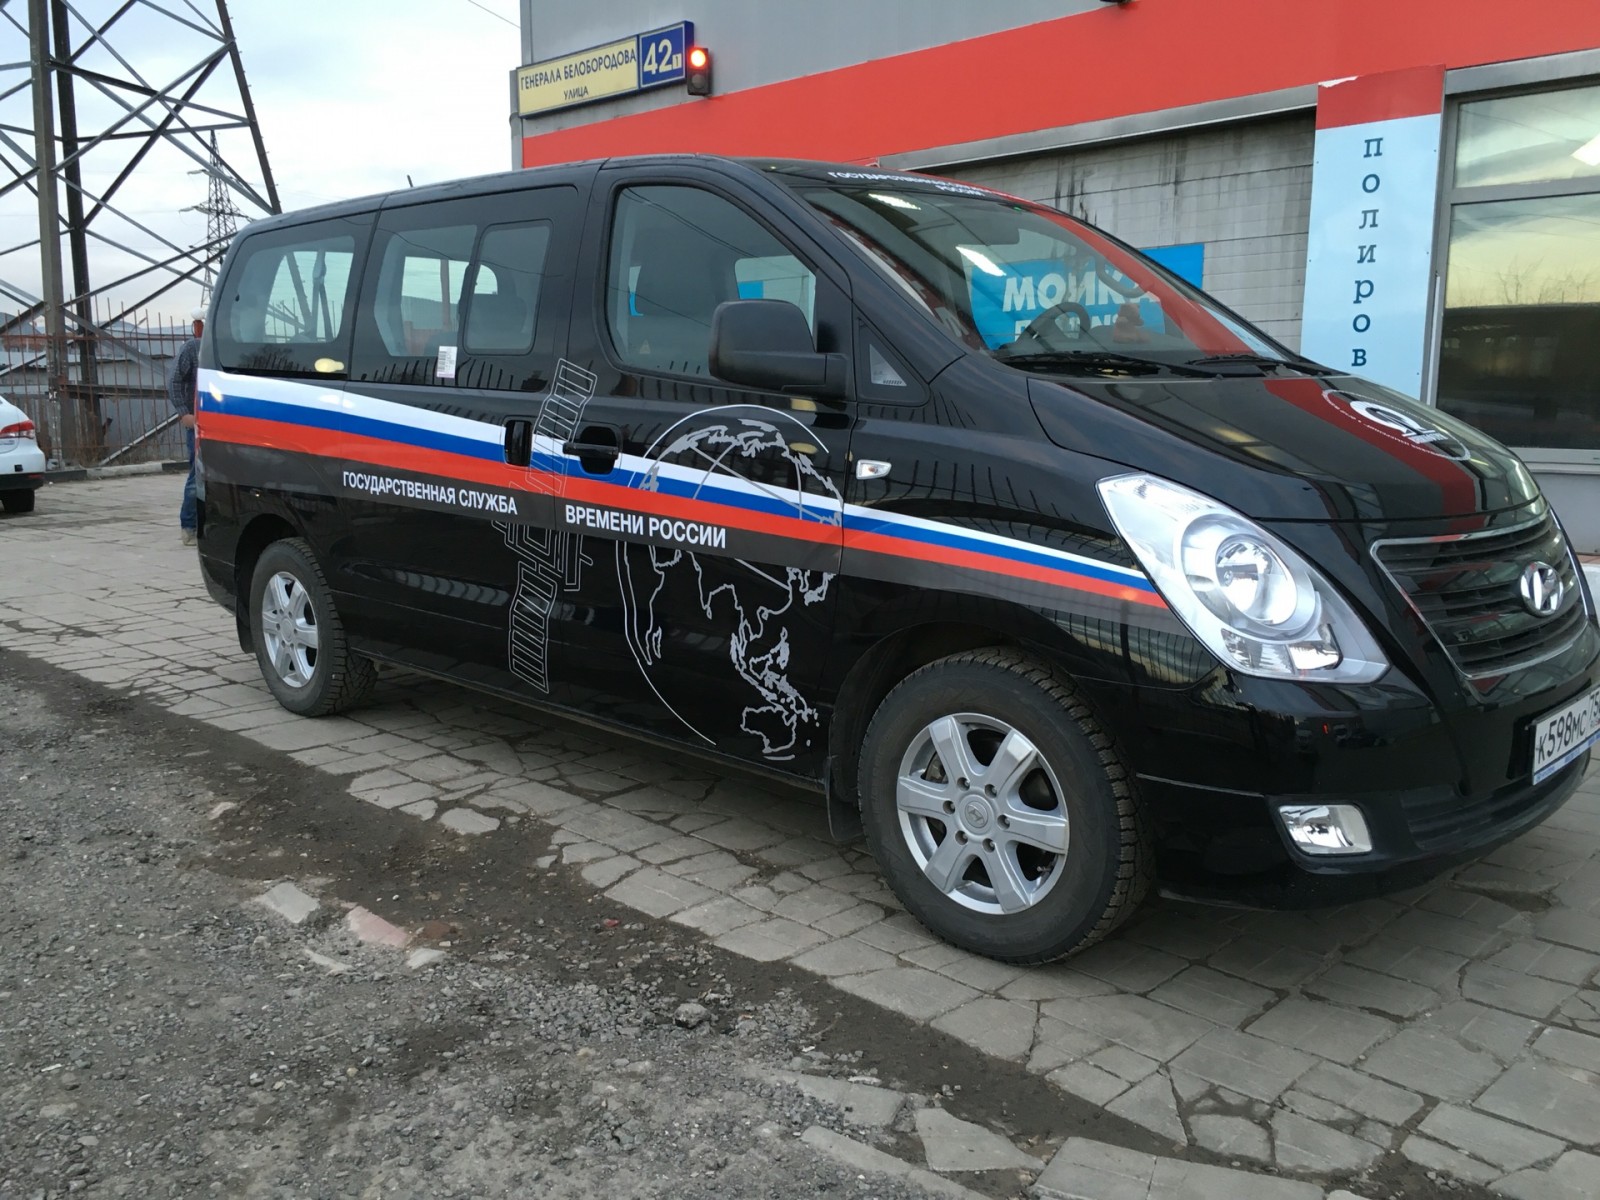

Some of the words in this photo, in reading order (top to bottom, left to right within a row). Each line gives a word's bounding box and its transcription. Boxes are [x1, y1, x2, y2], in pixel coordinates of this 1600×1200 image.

[520, 67, 562, 91] ГЕНЕРАЛА
[563, 48, 637, 80] БЕЛОБОРОДОВА
[563, 85, 589, 100] УЛИЦА
[343, 471, 456, 504] ГОСУДАРСТВЕННАЯ
[459, 489, 518, 515] СЛУЖБА
[565, 504, 644, 535] ВРЕМЕНИ
[649, 517, 726, 549] РОССИИ
